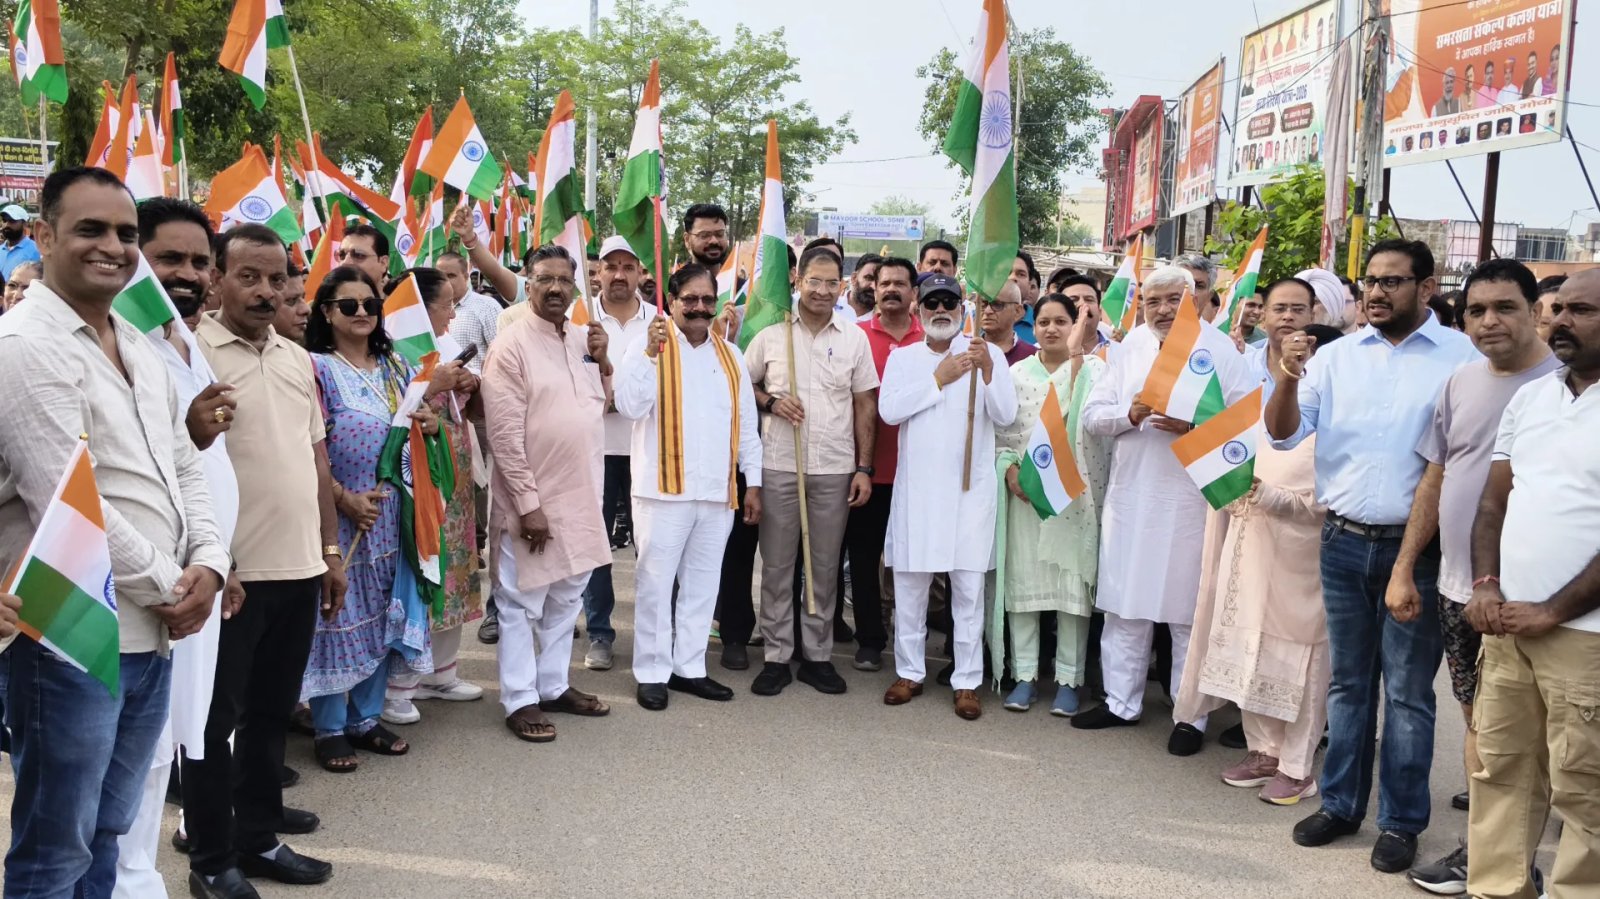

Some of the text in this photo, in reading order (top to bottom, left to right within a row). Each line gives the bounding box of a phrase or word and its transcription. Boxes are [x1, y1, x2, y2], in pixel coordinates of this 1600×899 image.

[1436, 27, 1472, 49] समरसता
[1474, 17, 1504, 38] संकल्प
[1506, 9, 1536, 28] कलश
[1537, 1, 1562, 19] यात्रा
[1462, 44, 1483, 60] आपका
[1483, 38, 1503, 56] हार्दिक
[1504, 33, 1527, 51] स्वागत
[1389, 97, 1553, 134] भाजपा अनुसूचित जाति मोर्चा
